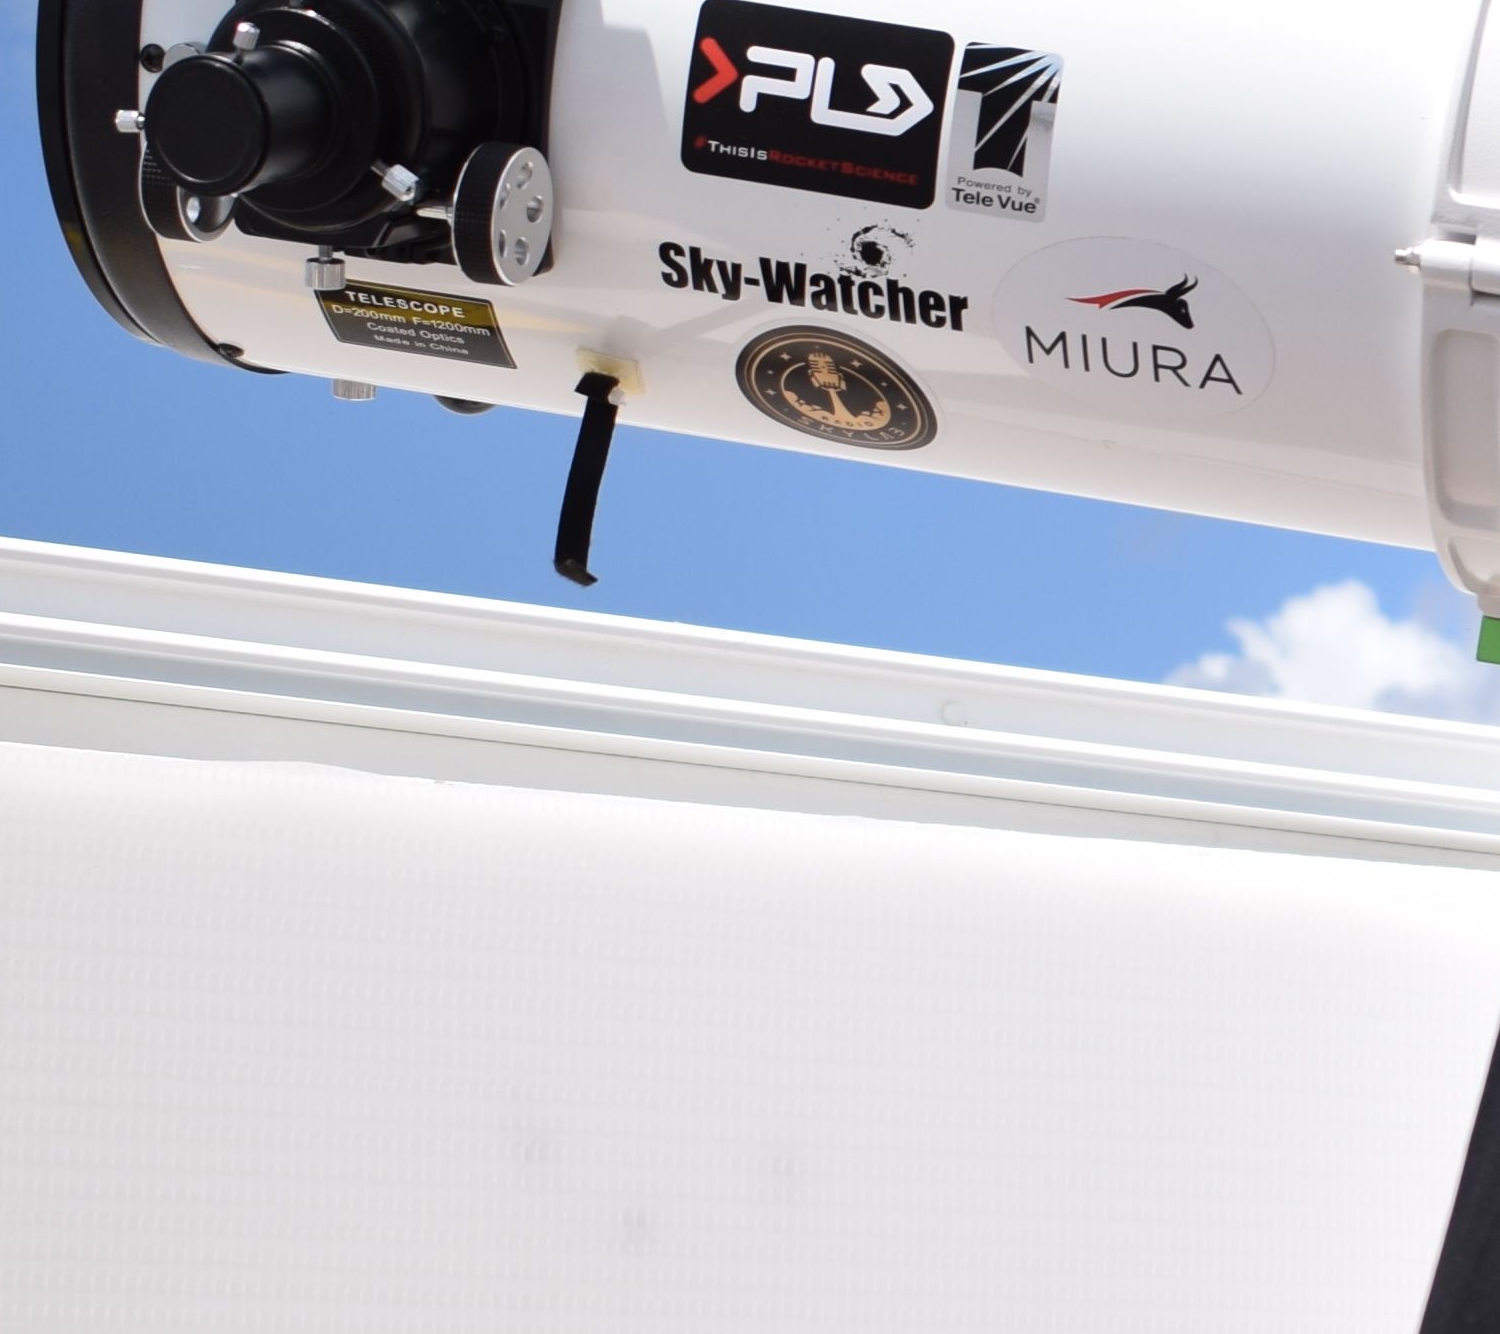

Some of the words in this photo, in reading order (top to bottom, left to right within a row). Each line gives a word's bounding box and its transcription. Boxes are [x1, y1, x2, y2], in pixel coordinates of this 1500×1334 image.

[951, 187, 994, 207] Tele
[957, 176, 1012, 193] Powered
[1018, 187, 1032, 198] by
[658, 241, 968, 332] Sky-Watcher
[345, 290, 465, 318] TELESCOPE
[332, 304, 407, 324] D=200mm
[412, 316, 491, 337] F=1200mm
[366, 321, 416, 337] Coated
[419, 330, 465, 345] Optics
[374, 334, 410, 346] Made
[414, 340, 426, 349] in
[429, 343, 469, 355] China
[1025, 325, 1243, 396] MIURA
